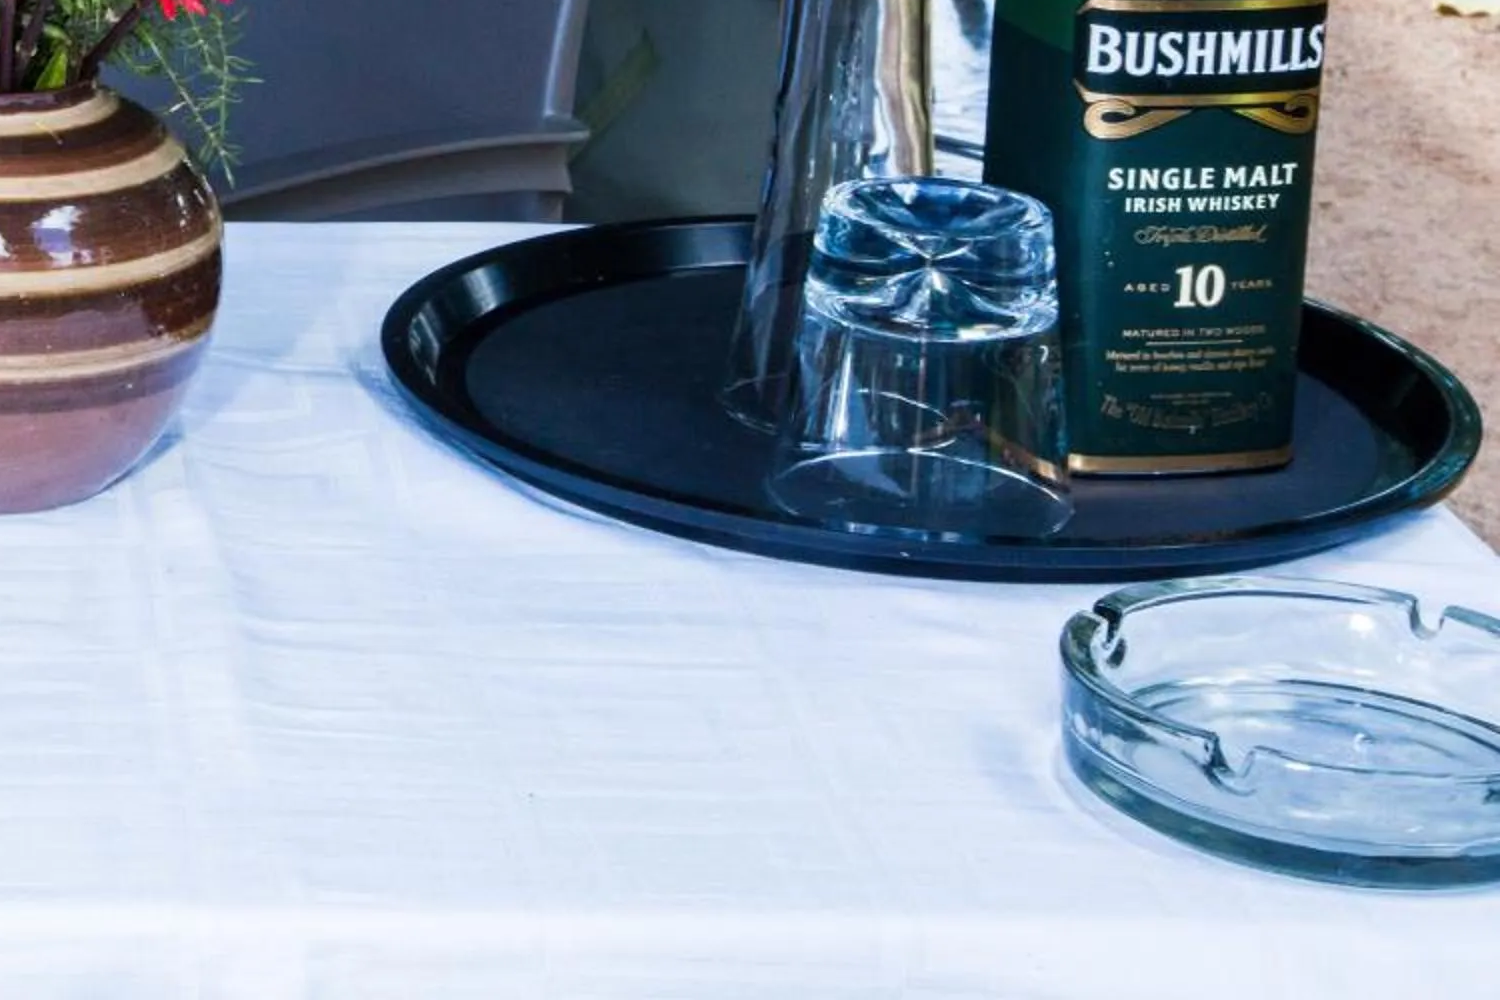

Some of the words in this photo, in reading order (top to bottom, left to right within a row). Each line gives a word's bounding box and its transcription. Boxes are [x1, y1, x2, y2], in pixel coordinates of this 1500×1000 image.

[1087, 23, 1324, 77] BUSHMILLS
[1108, 167, 1215, 190] SINGLE
[1223, 163, 1298, 188] MALT
[1125, 197, 1182, 213] IRISH
[1187, 193, 1280, 212] WHISKEY
[1123, 282, 1171, 293] AGED
[1173, 264, 1226, 308] 10
[1121, 328, 1181, 338] MATURED
